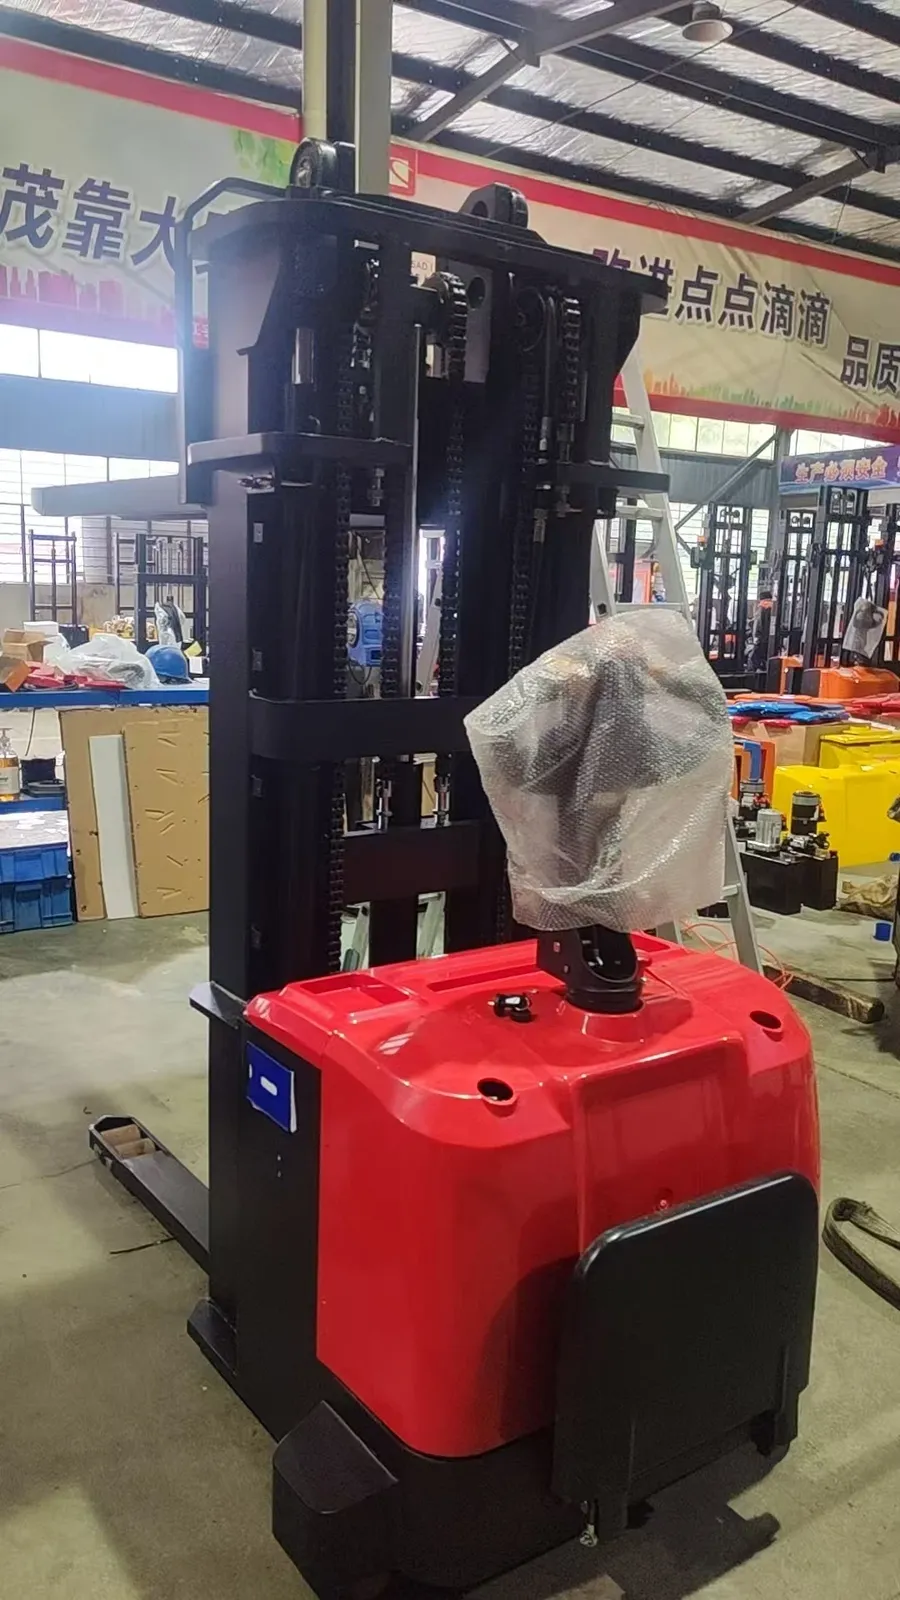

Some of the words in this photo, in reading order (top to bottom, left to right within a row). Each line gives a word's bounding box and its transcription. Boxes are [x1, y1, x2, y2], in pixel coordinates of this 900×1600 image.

[794, 456, 888, 484] 生产必须安全
